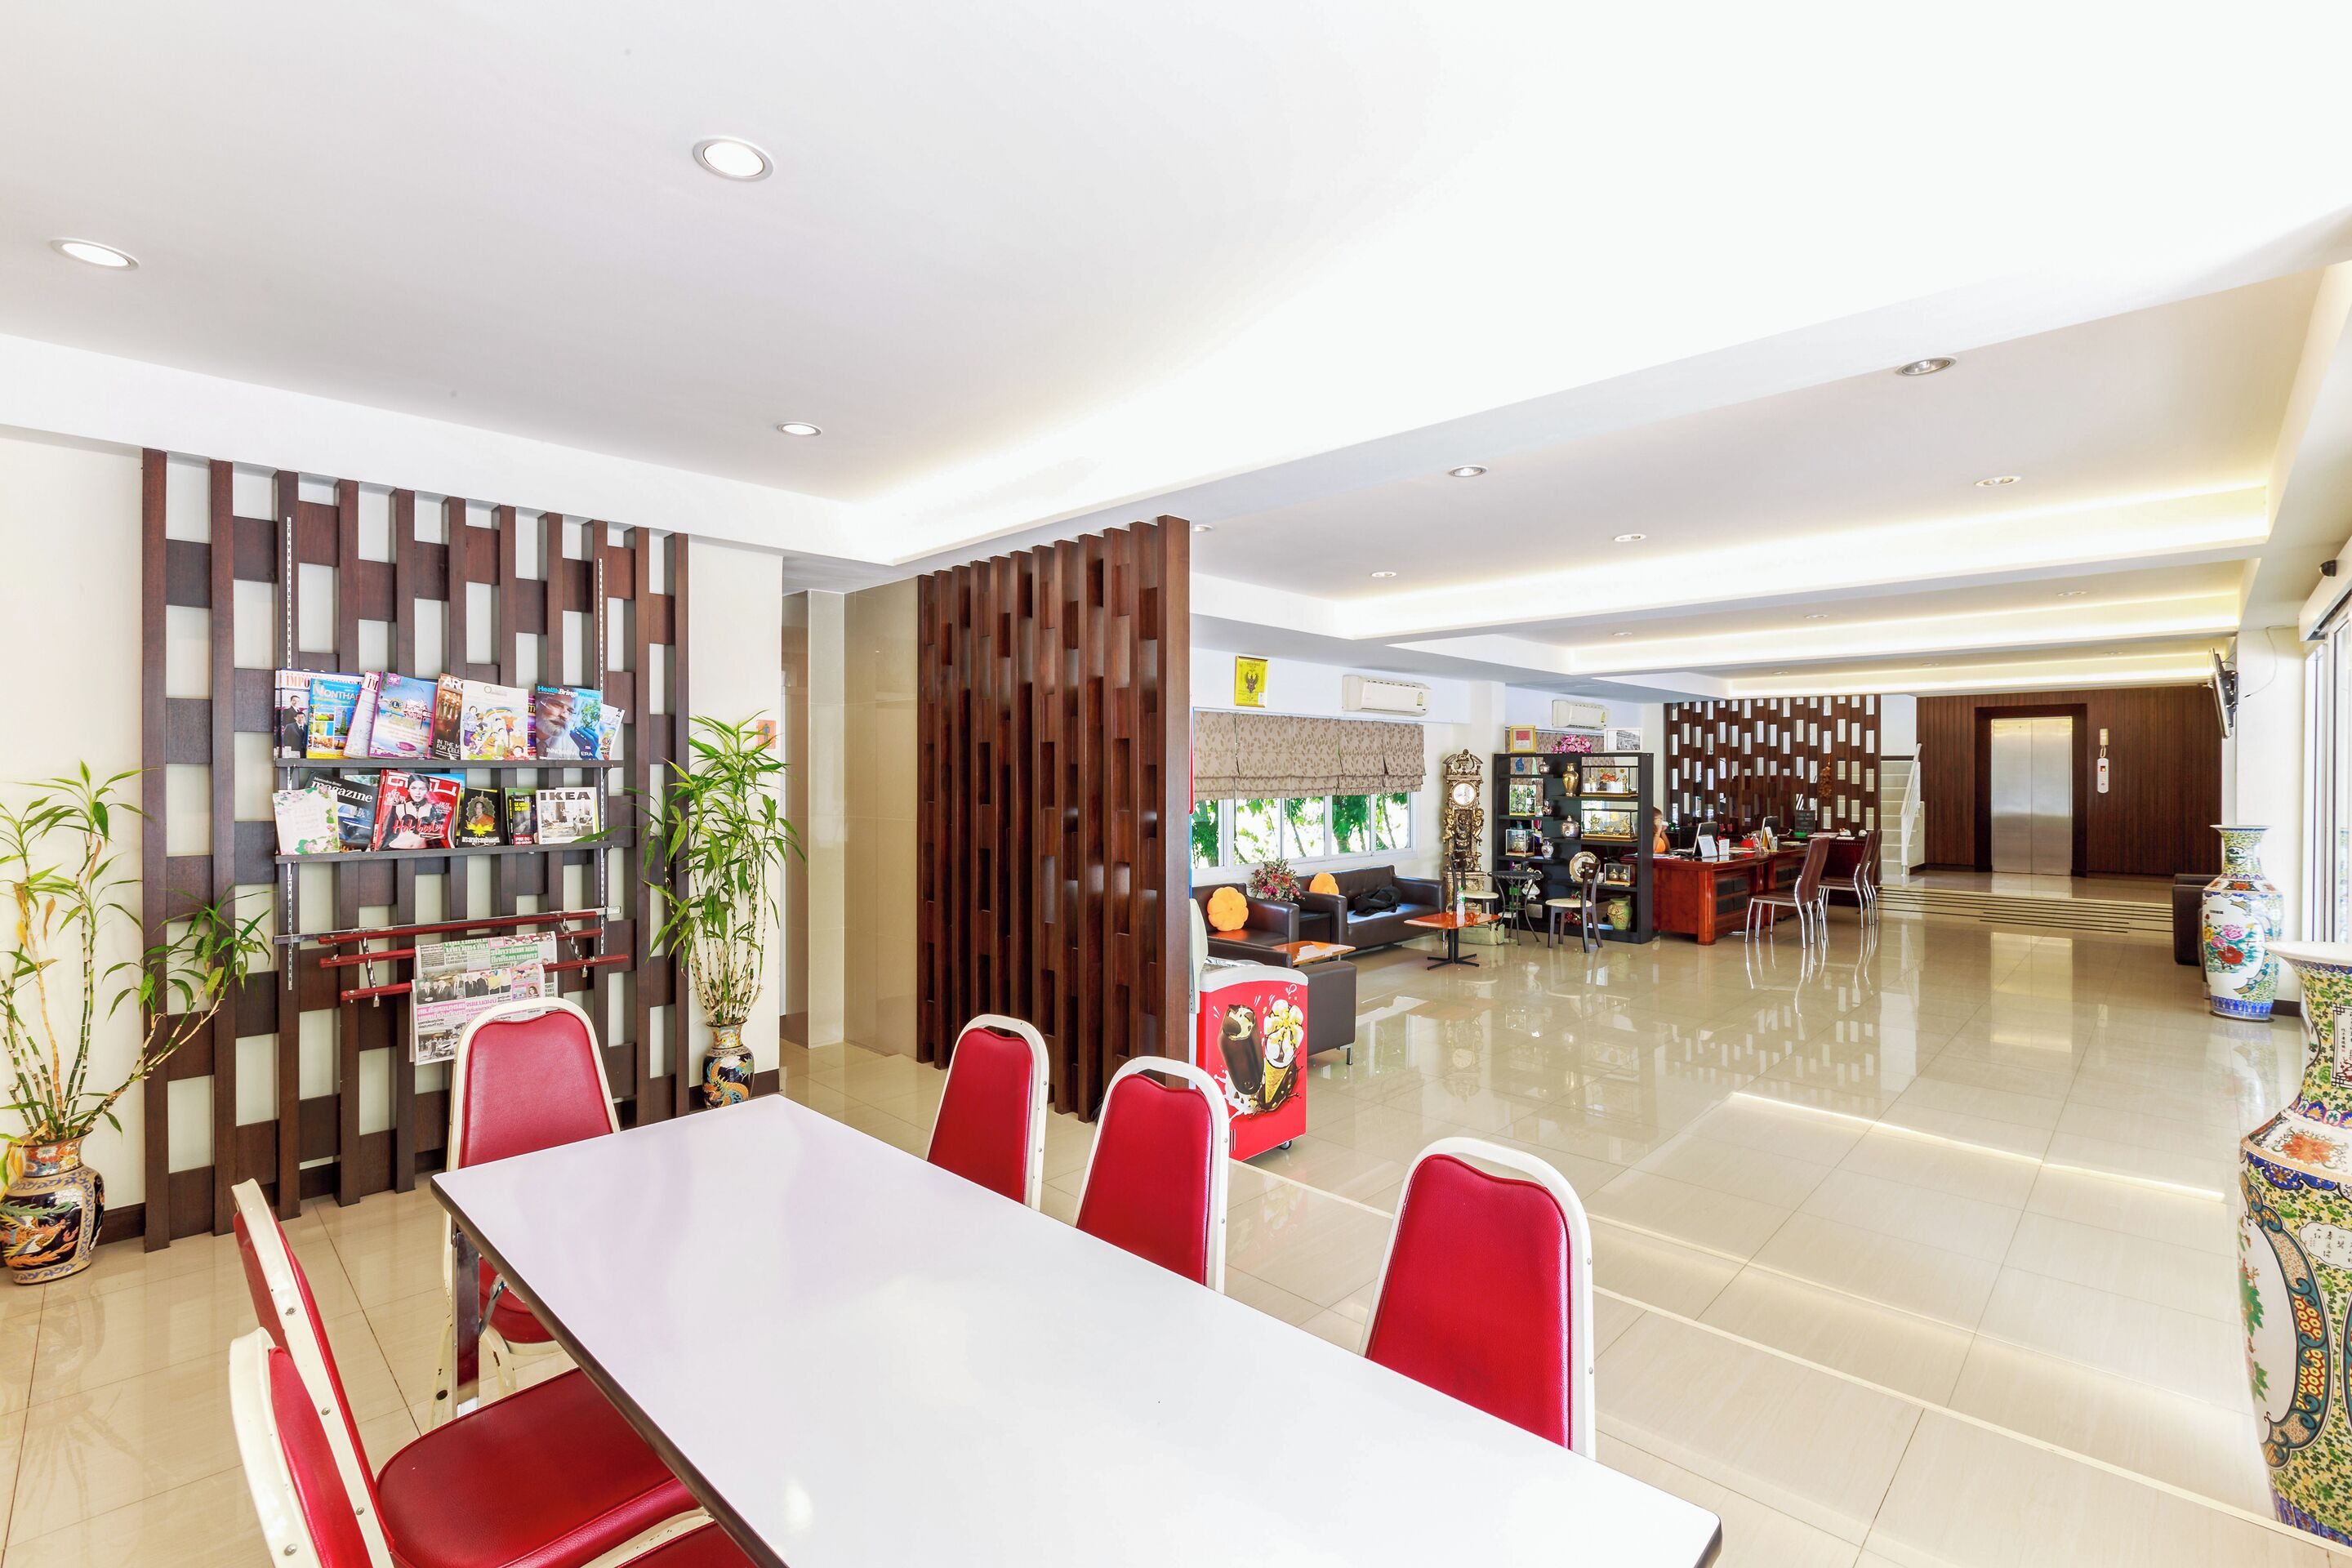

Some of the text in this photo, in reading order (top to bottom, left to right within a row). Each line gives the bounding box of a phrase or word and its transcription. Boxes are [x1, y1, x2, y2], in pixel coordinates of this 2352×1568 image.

[313, 684, 359, 701] NONTHA
[540, 791, 591, 800] IKEA
[393, 818, 416, 834] Hot
